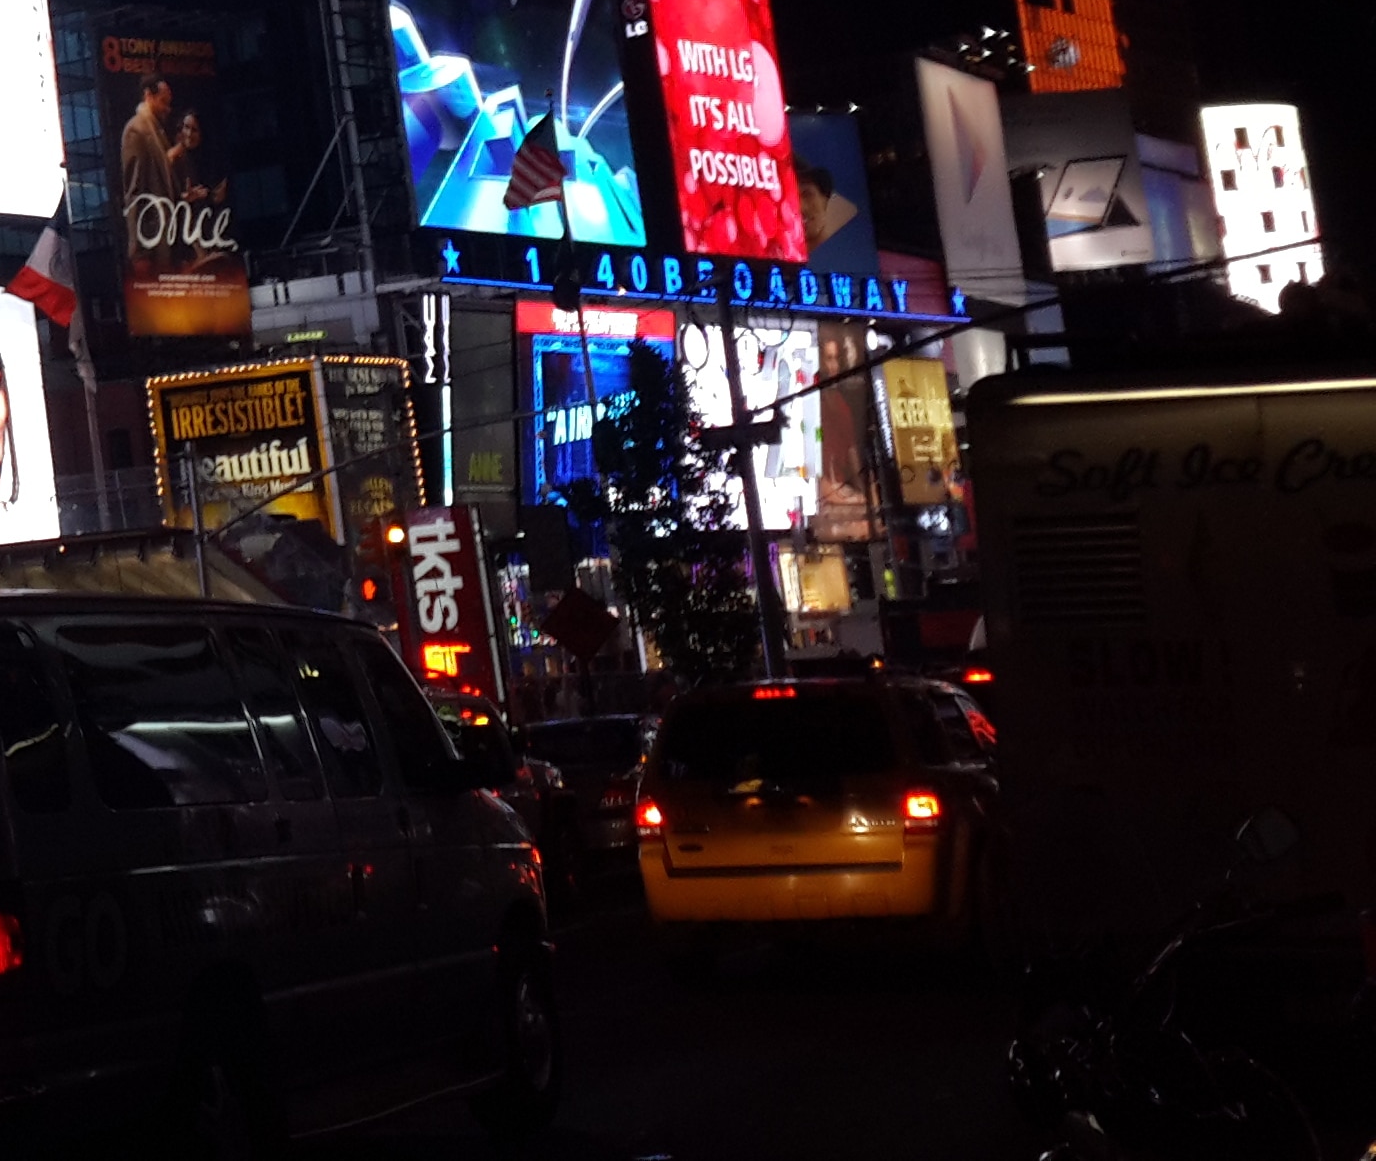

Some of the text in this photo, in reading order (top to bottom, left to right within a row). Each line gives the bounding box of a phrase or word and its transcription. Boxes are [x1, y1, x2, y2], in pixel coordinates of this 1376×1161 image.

[624, 22, 648, 39] LG
[676, 38, 759, 85] WITH LG,
[688, 94, 761, 137] IT'S ALL
[688, 149, 780, 193] POSSIBLE!
[524, 245, 648, 292] 140
[170, 392, 307, 441] IRRESISTIBLE!
[1037, 445, 1160, 503] Soft
[1174, 442, 1263, 491] Ice
[408, 516, 465, 637] tkts
[44, 889, 128, 997] GO
